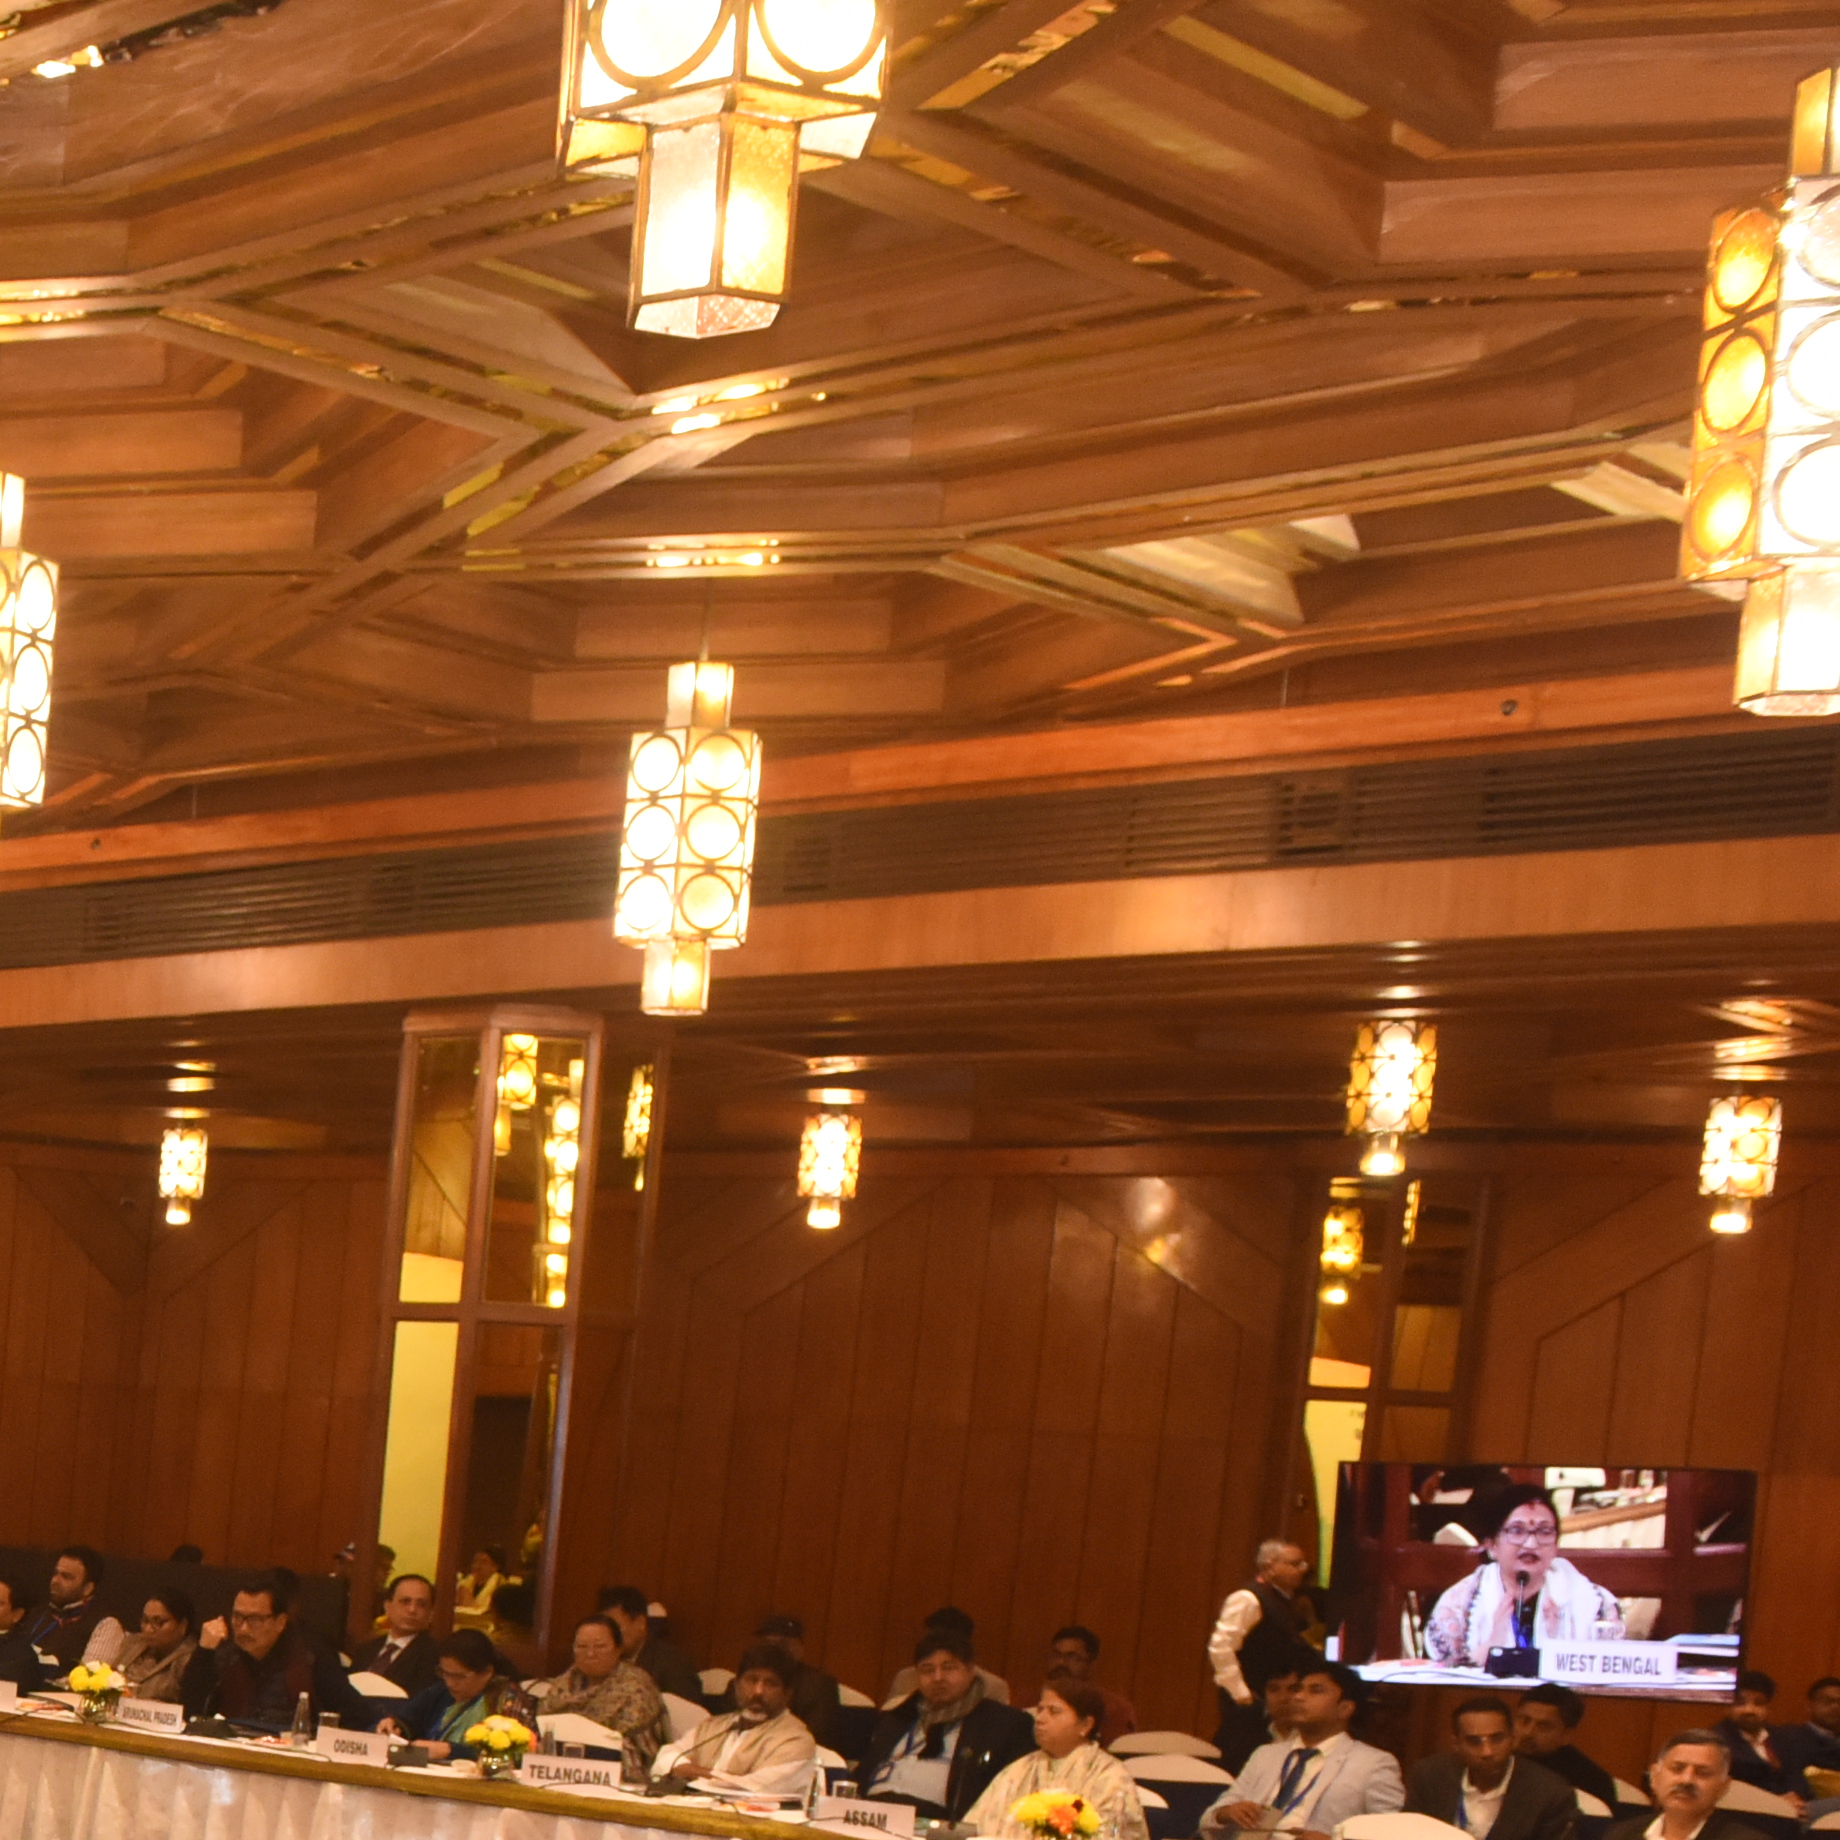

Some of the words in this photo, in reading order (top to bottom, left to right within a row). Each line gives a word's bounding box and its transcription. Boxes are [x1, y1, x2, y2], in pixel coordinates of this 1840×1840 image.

[1556, 1653, 1597, 1672] WEST
[1601, 1655, 1662, 1676] BENGAL
[333, 1739, 369, 1756] ODISHA
[529, 1764, 611, 1786] TELANGANA
[843, 1809, 888, 1830] ASSAM
